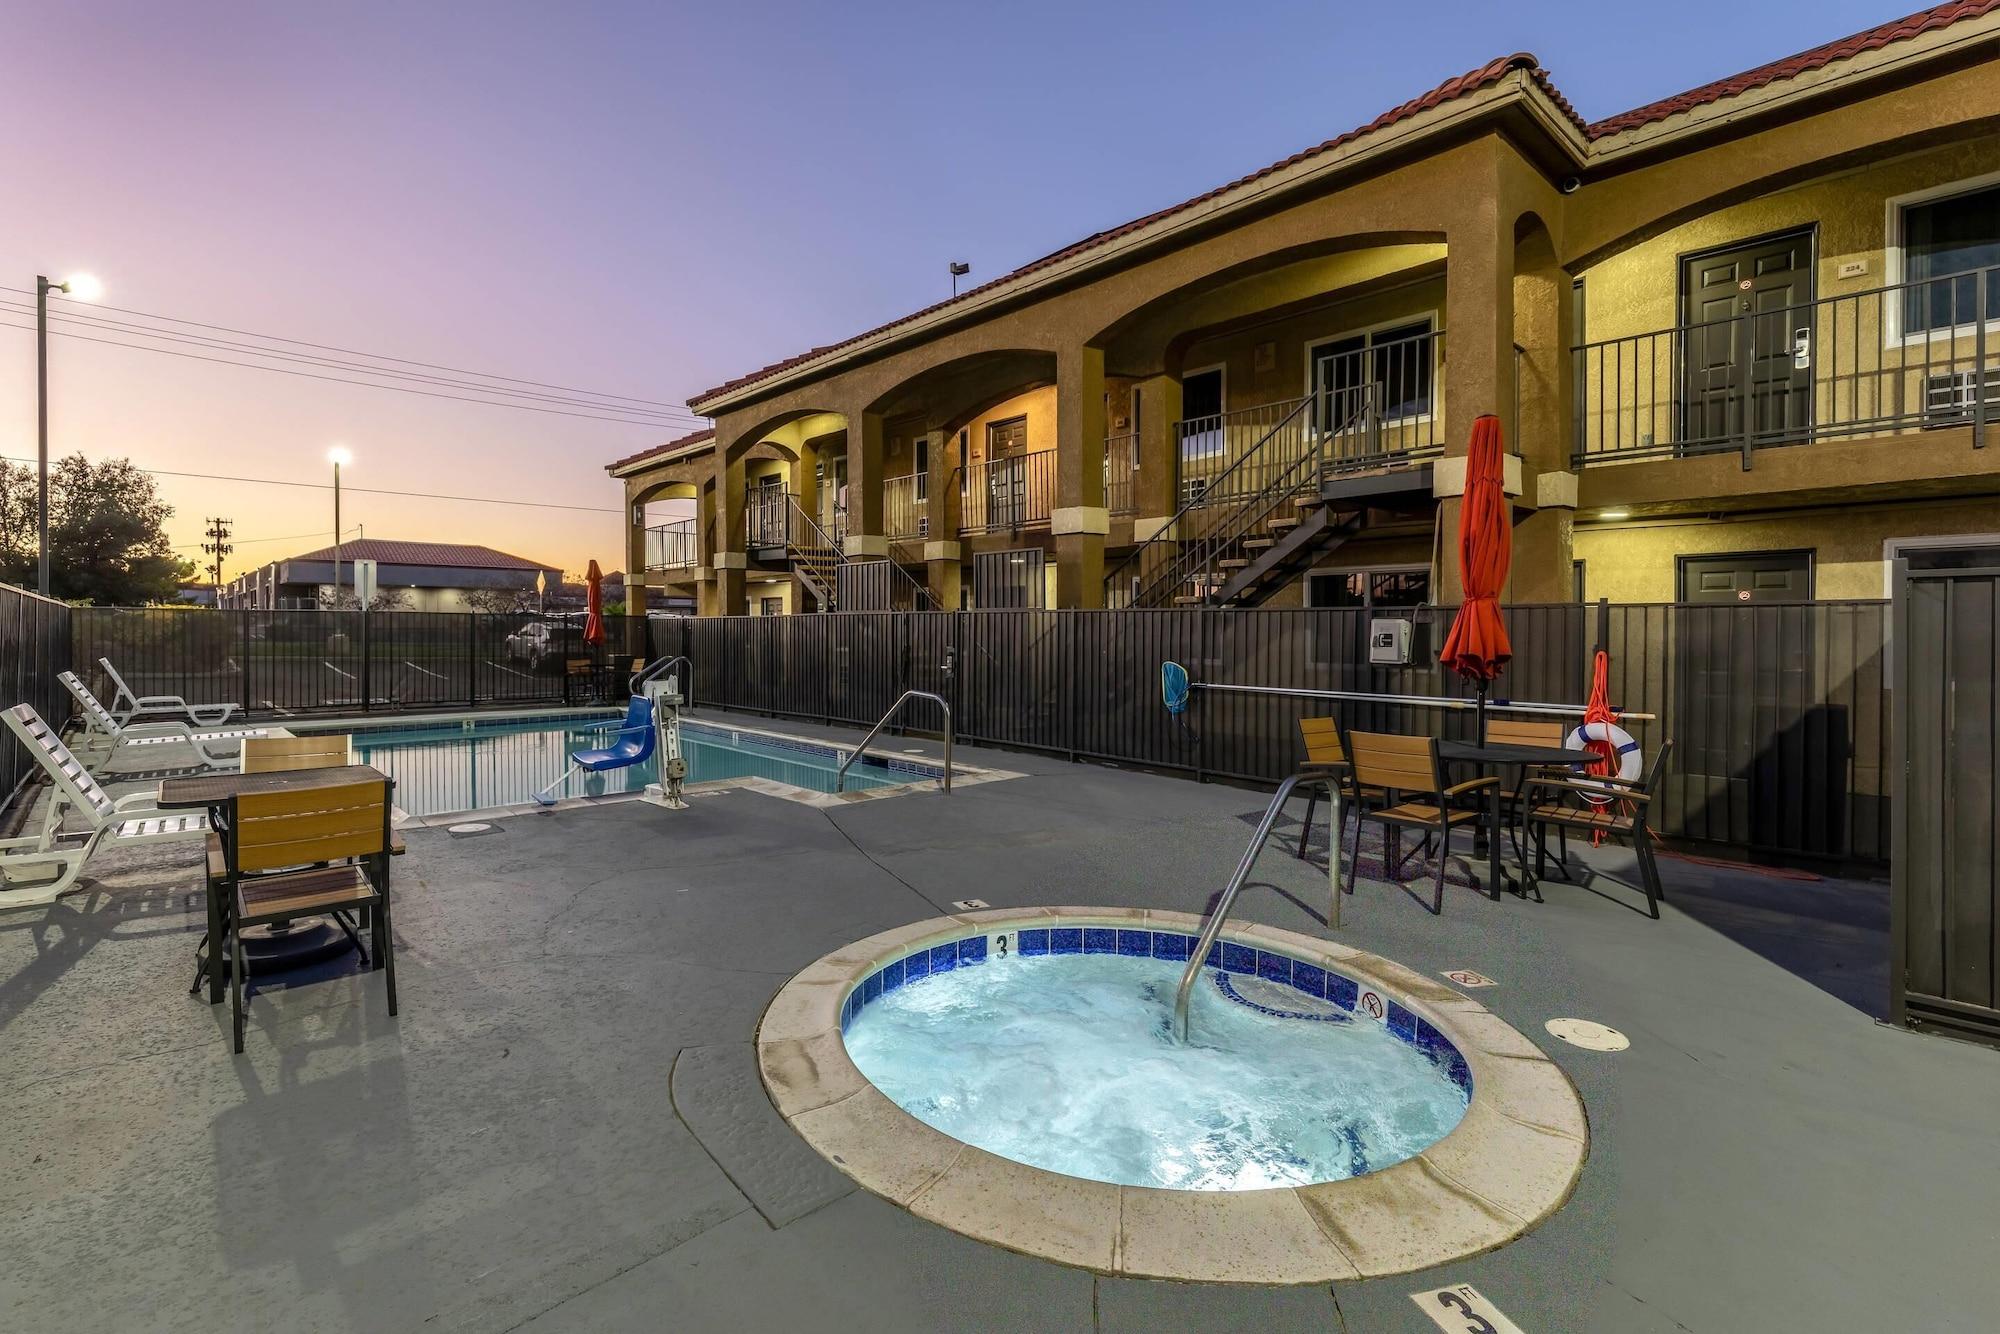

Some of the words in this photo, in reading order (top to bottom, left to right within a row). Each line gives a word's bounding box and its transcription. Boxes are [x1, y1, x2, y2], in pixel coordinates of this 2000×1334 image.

[996, 935, 1008, 959] 3
[1458, 1287, 1478, 1301] FT
[1437, 1291, 1497, 1334] 3
